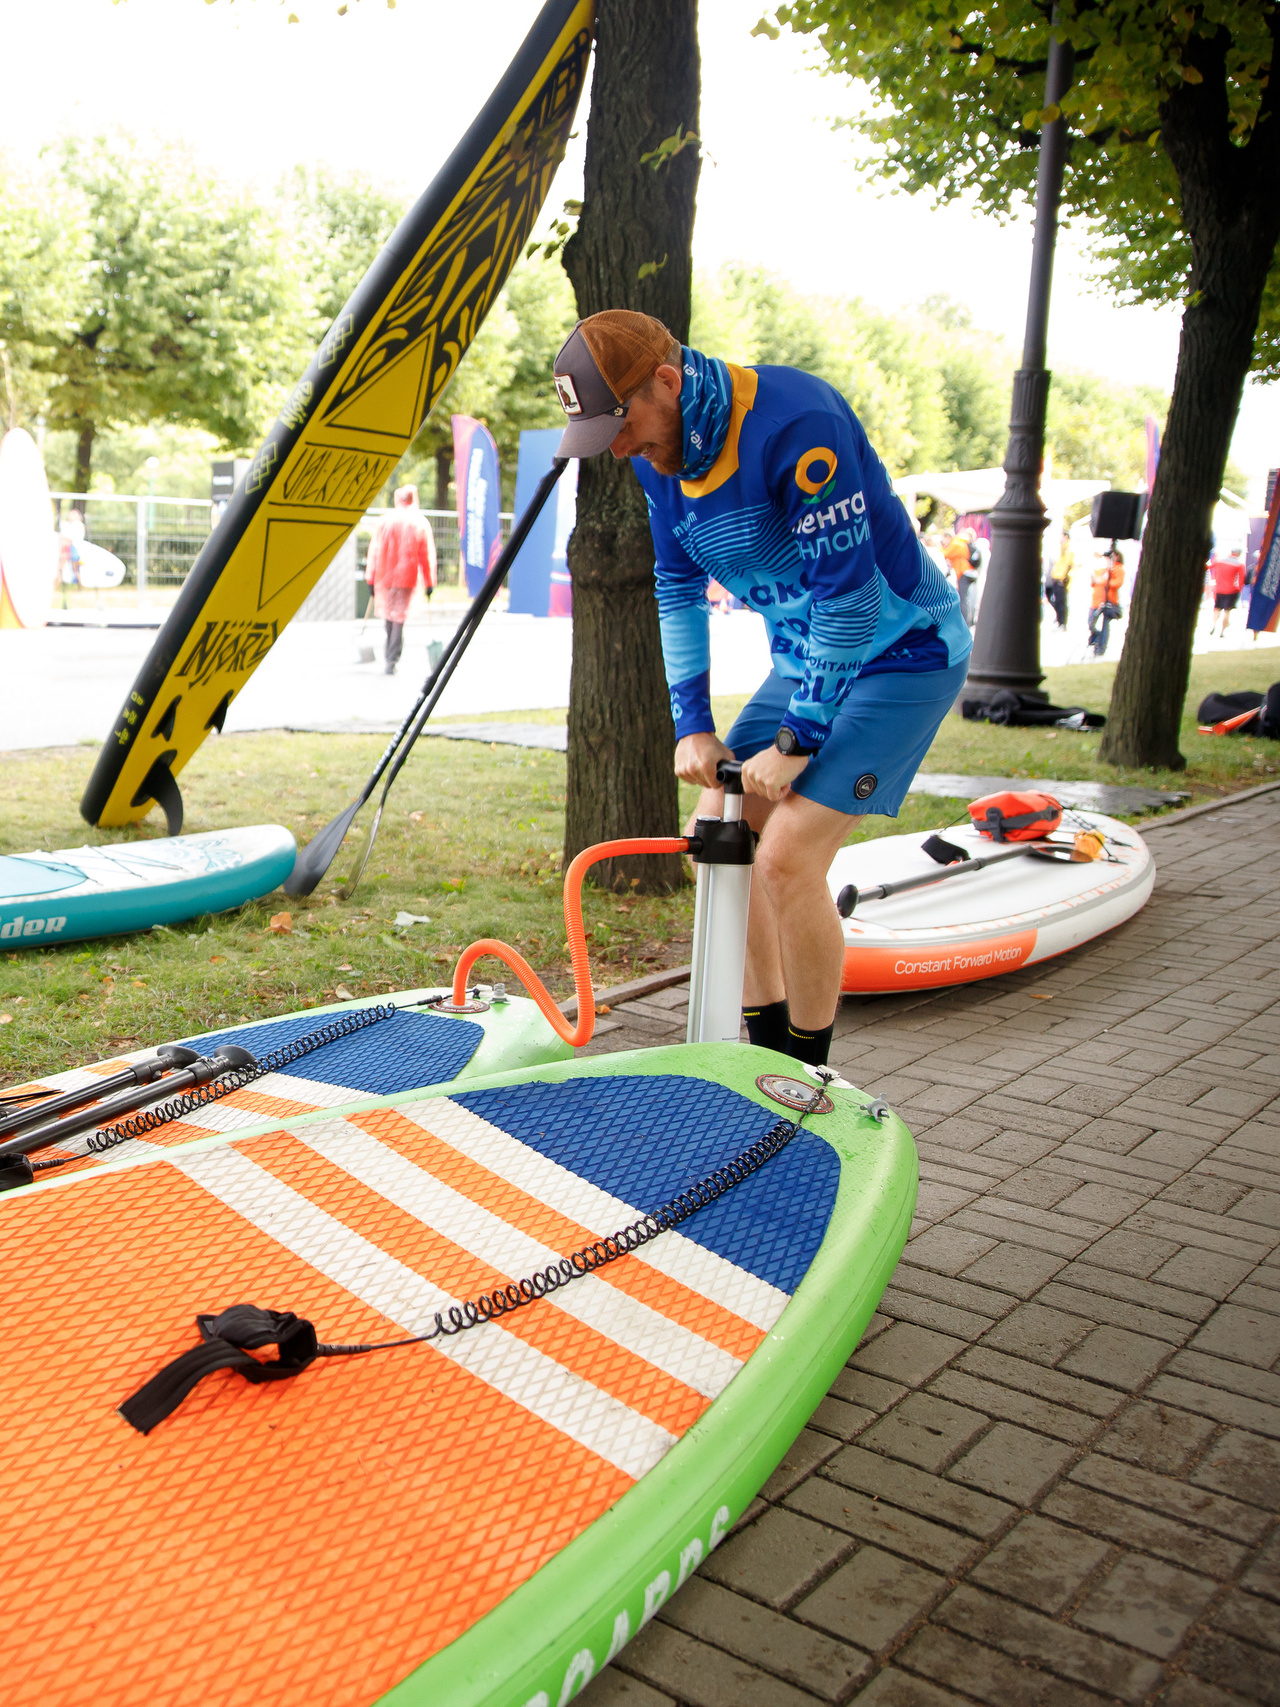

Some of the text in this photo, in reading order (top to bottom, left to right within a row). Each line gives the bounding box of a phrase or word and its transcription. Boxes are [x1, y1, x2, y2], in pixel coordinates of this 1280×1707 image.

[807, 655, 865, 673] ОНТАН
[894, 946, 1022, 975] Constant Forward Motion
